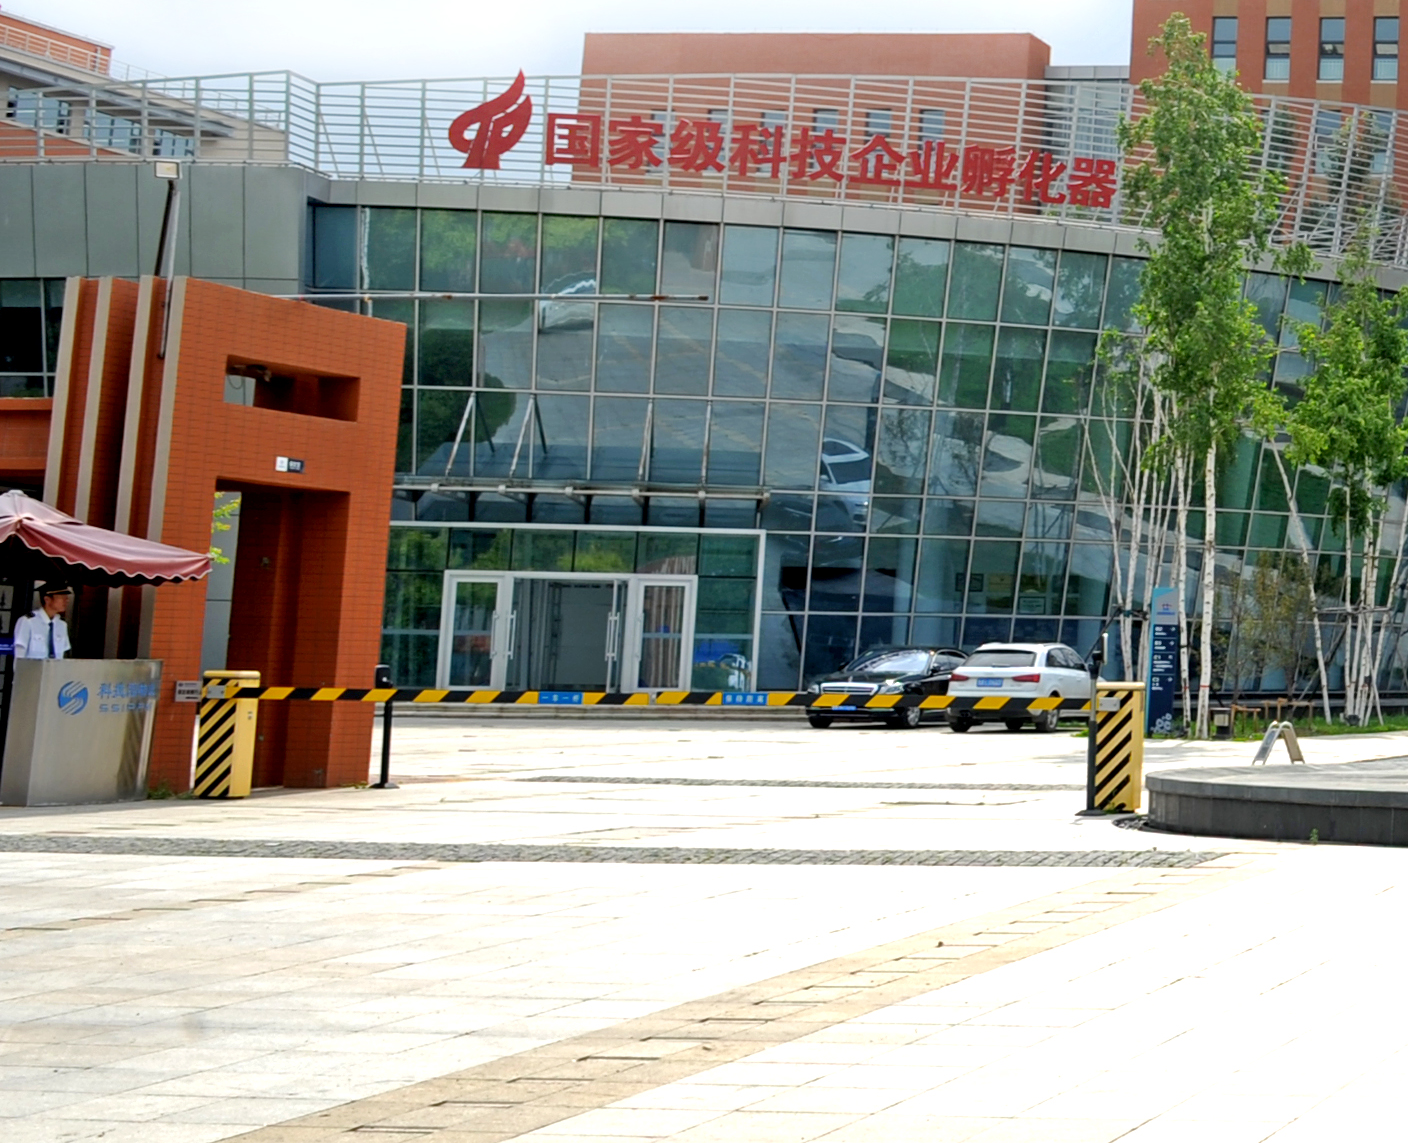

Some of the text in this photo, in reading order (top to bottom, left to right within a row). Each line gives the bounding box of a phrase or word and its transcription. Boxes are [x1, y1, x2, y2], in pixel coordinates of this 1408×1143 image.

[545, 112, 1117, 208] 国家级科技企业孵化器
